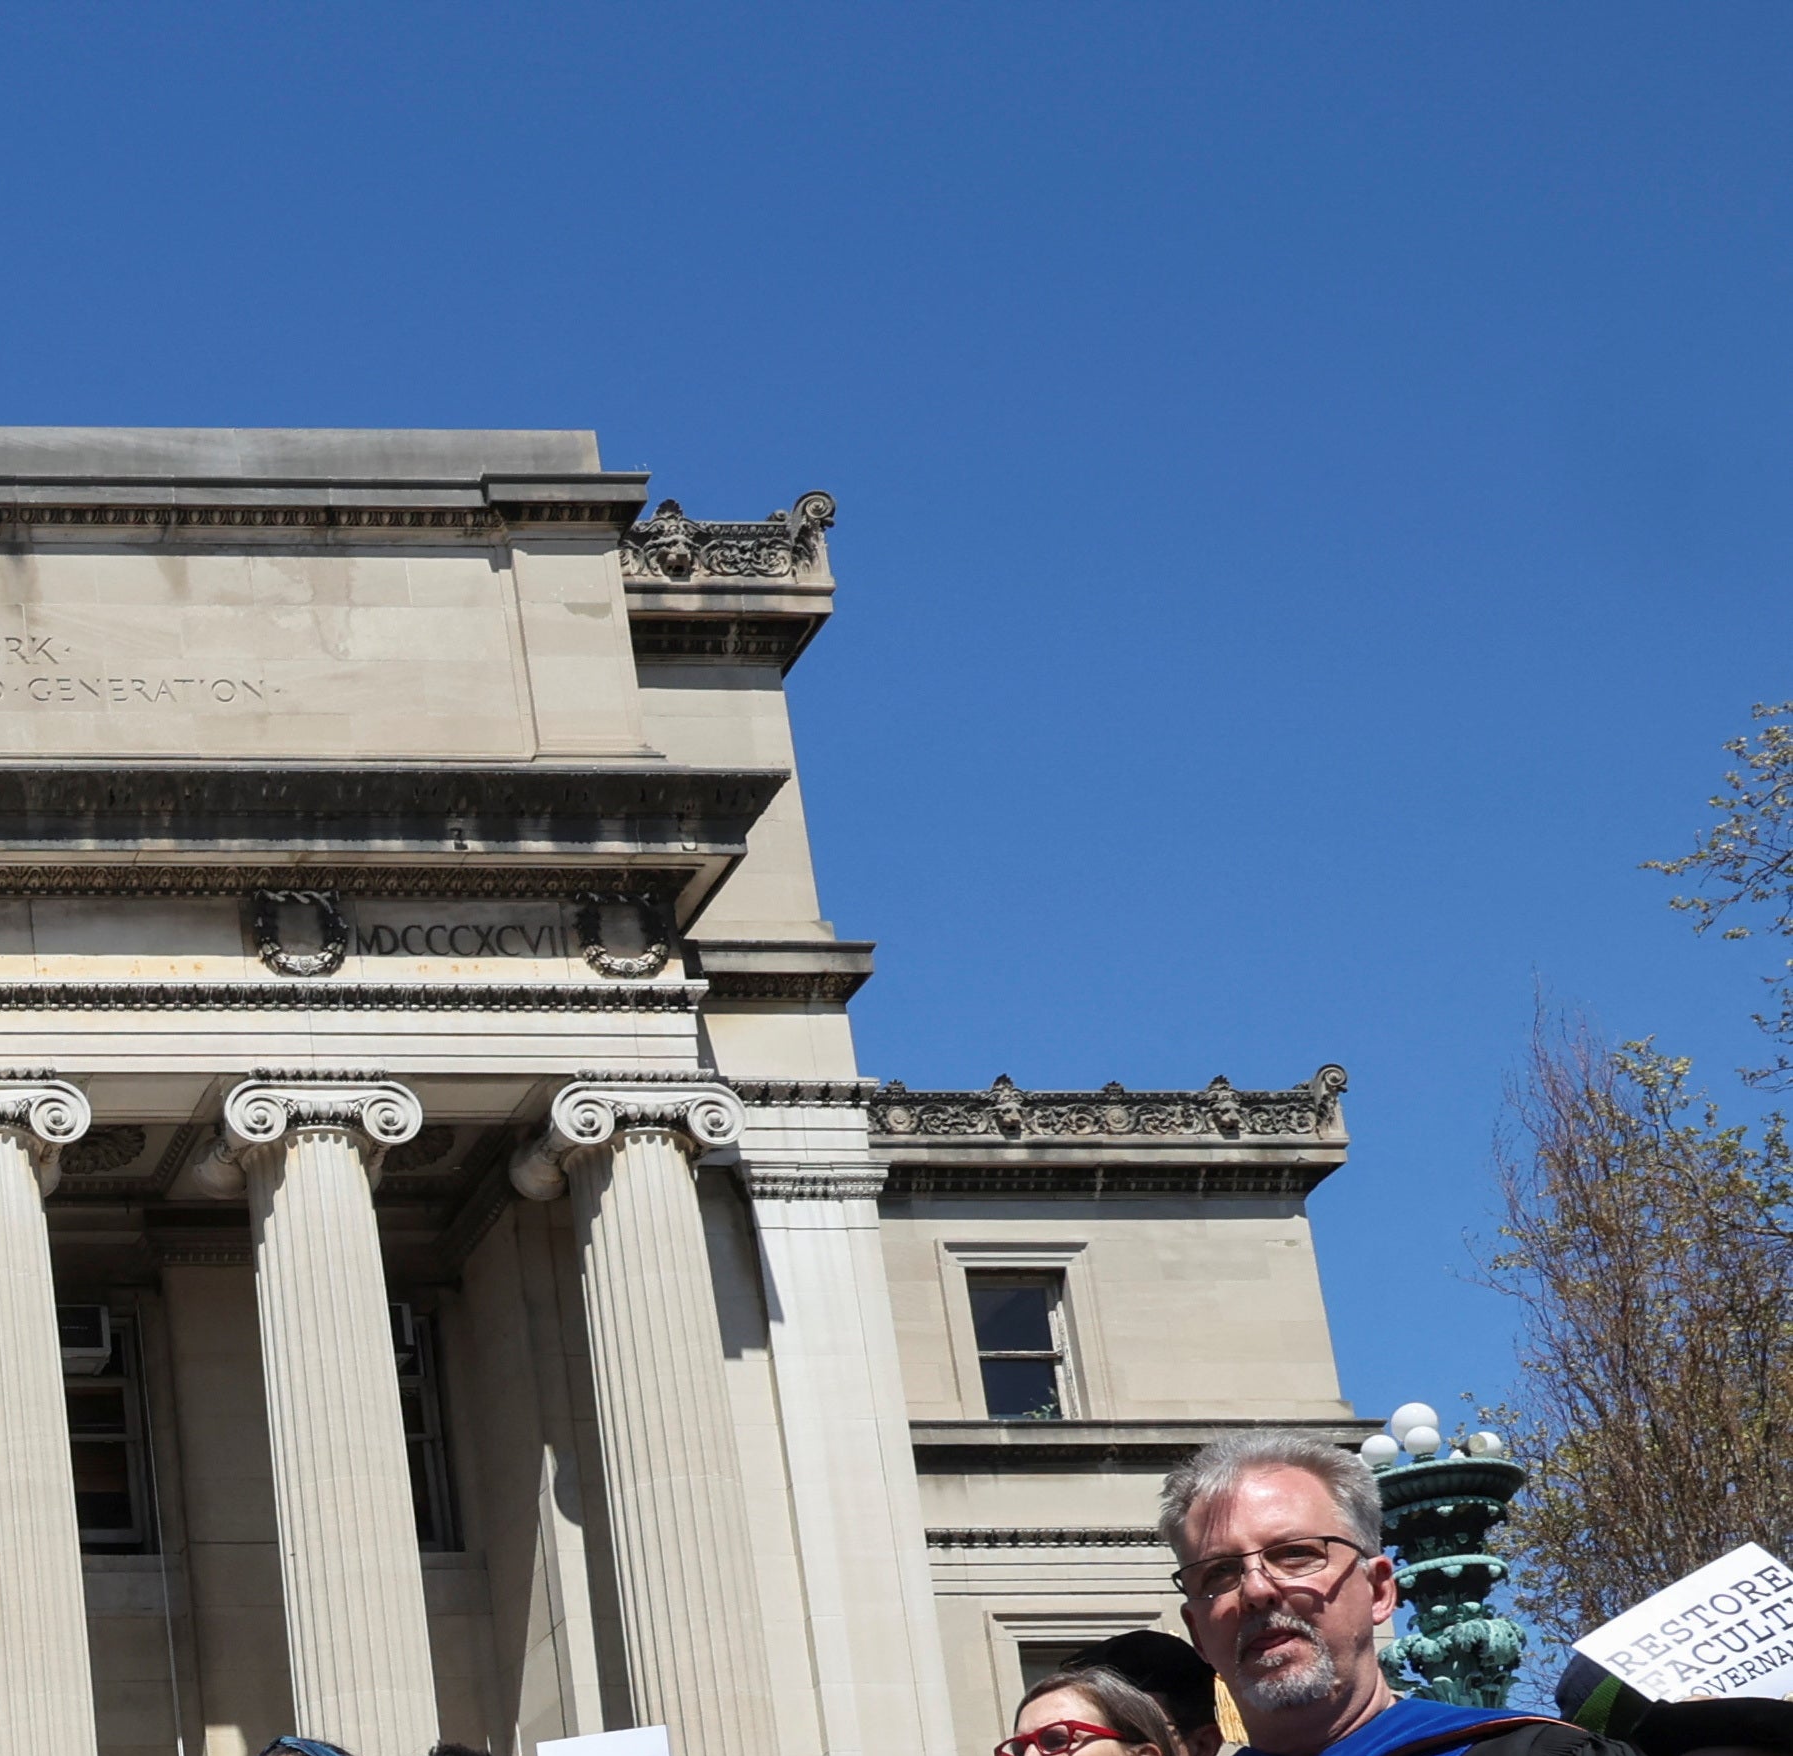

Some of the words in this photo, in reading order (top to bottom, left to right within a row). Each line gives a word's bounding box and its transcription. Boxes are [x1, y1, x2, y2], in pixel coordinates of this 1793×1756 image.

[28, 677, 265, 703] GENERATION
[1604, 1565, 1793, 1676] RESTORE
[1679, 1641, 1793, 1697] OVERNA
